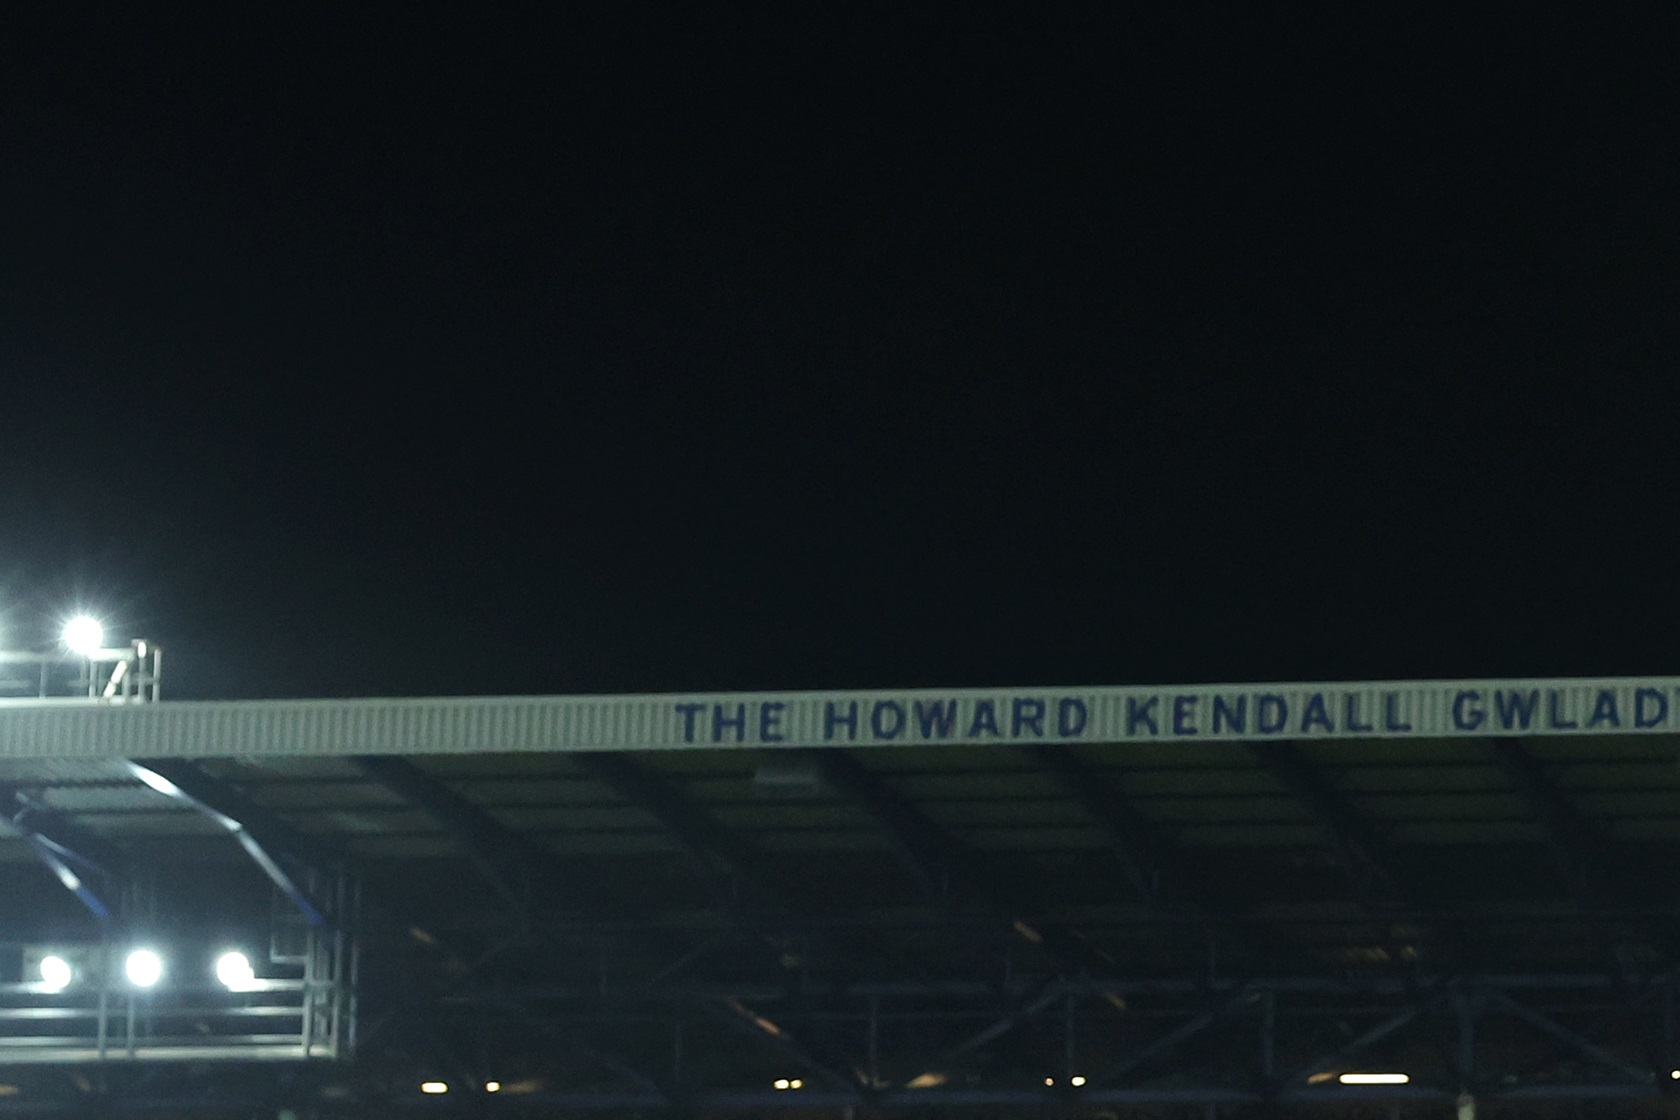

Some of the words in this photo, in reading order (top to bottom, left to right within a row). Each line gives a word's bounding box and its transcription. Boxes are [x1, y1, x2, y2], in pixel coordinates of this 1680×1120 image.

[675, 701, 786, 743] THE
[822, 697, 1088, 742] HOWARD
[1124, 692, 1413, 738] KENDALL
